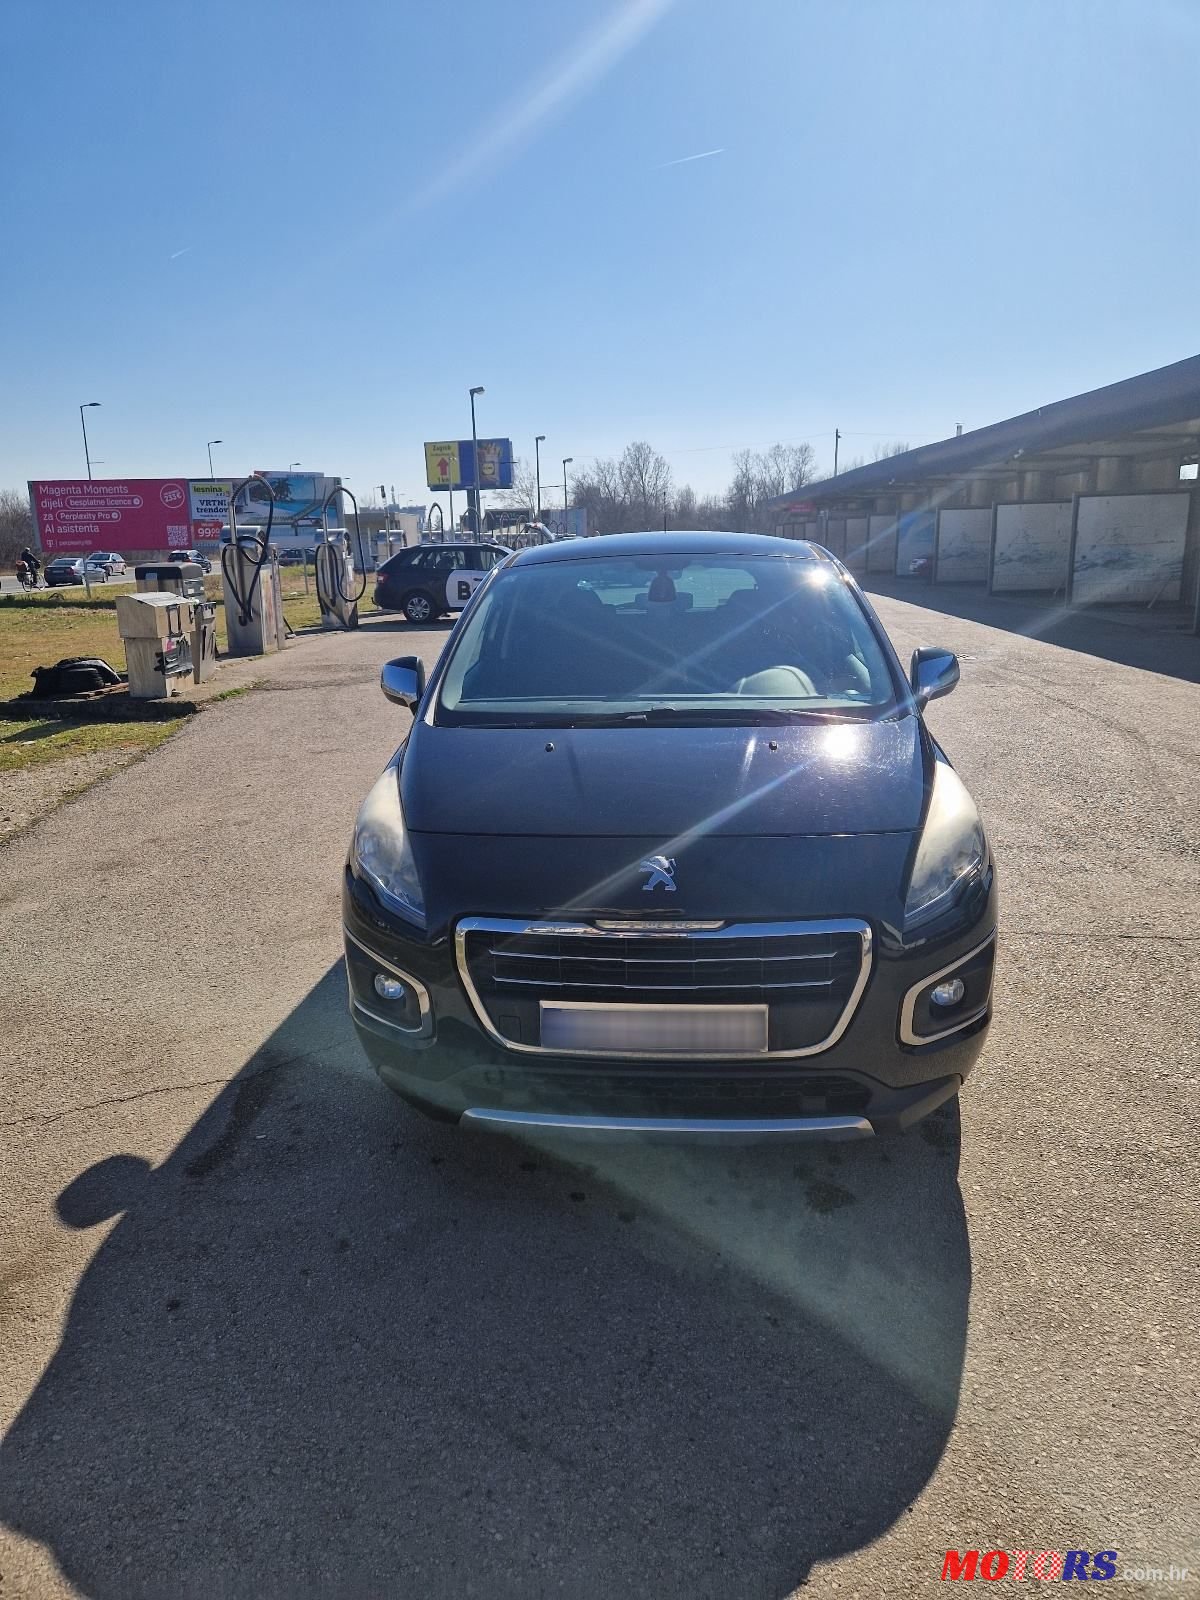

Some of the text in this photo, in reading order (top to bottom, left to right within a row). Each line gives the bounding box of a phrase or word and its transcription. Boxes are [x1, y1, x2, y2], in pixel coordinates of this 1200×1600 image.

[39, 485, 129, 496] Magenta Moments
[193, 485, 223, 493] lesnina
[41, 498, 132, 510] dijeli besplatne licence
[199, 499, 227, 507] VRTNI
[43, 512, 110, 521] za Perplexity Pro
[45, 524, 100, 534] AI asistenta
